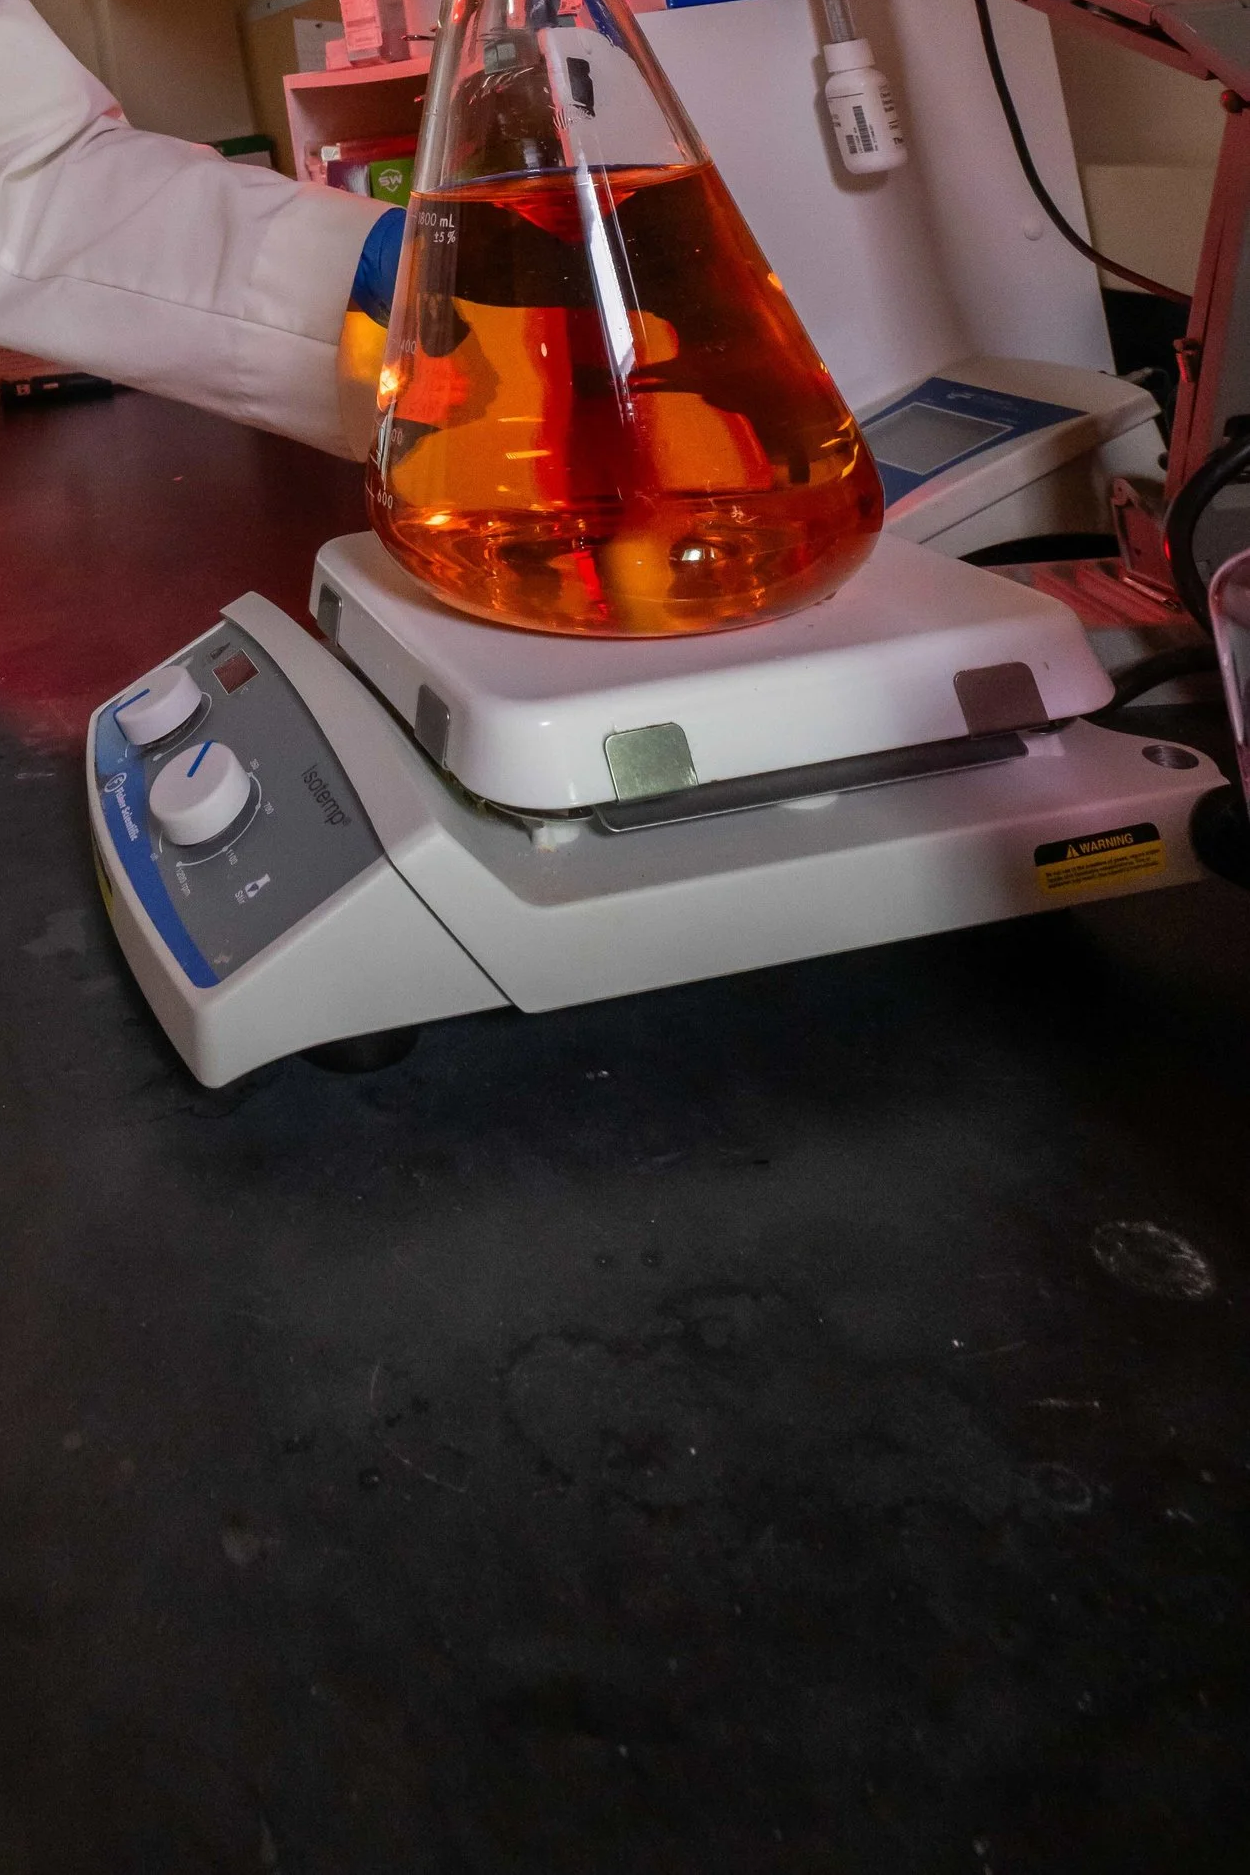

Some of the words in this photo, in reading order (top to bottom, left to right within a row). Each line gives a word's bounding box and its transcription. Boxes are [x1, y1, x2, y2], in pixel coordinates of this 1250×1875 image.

[439, 213, 455, 228] mL
[1079, 833, 1134, 854] WARNING
[225, 849, 238, 865] 1100
[235, 890, 246, 905] Stir
